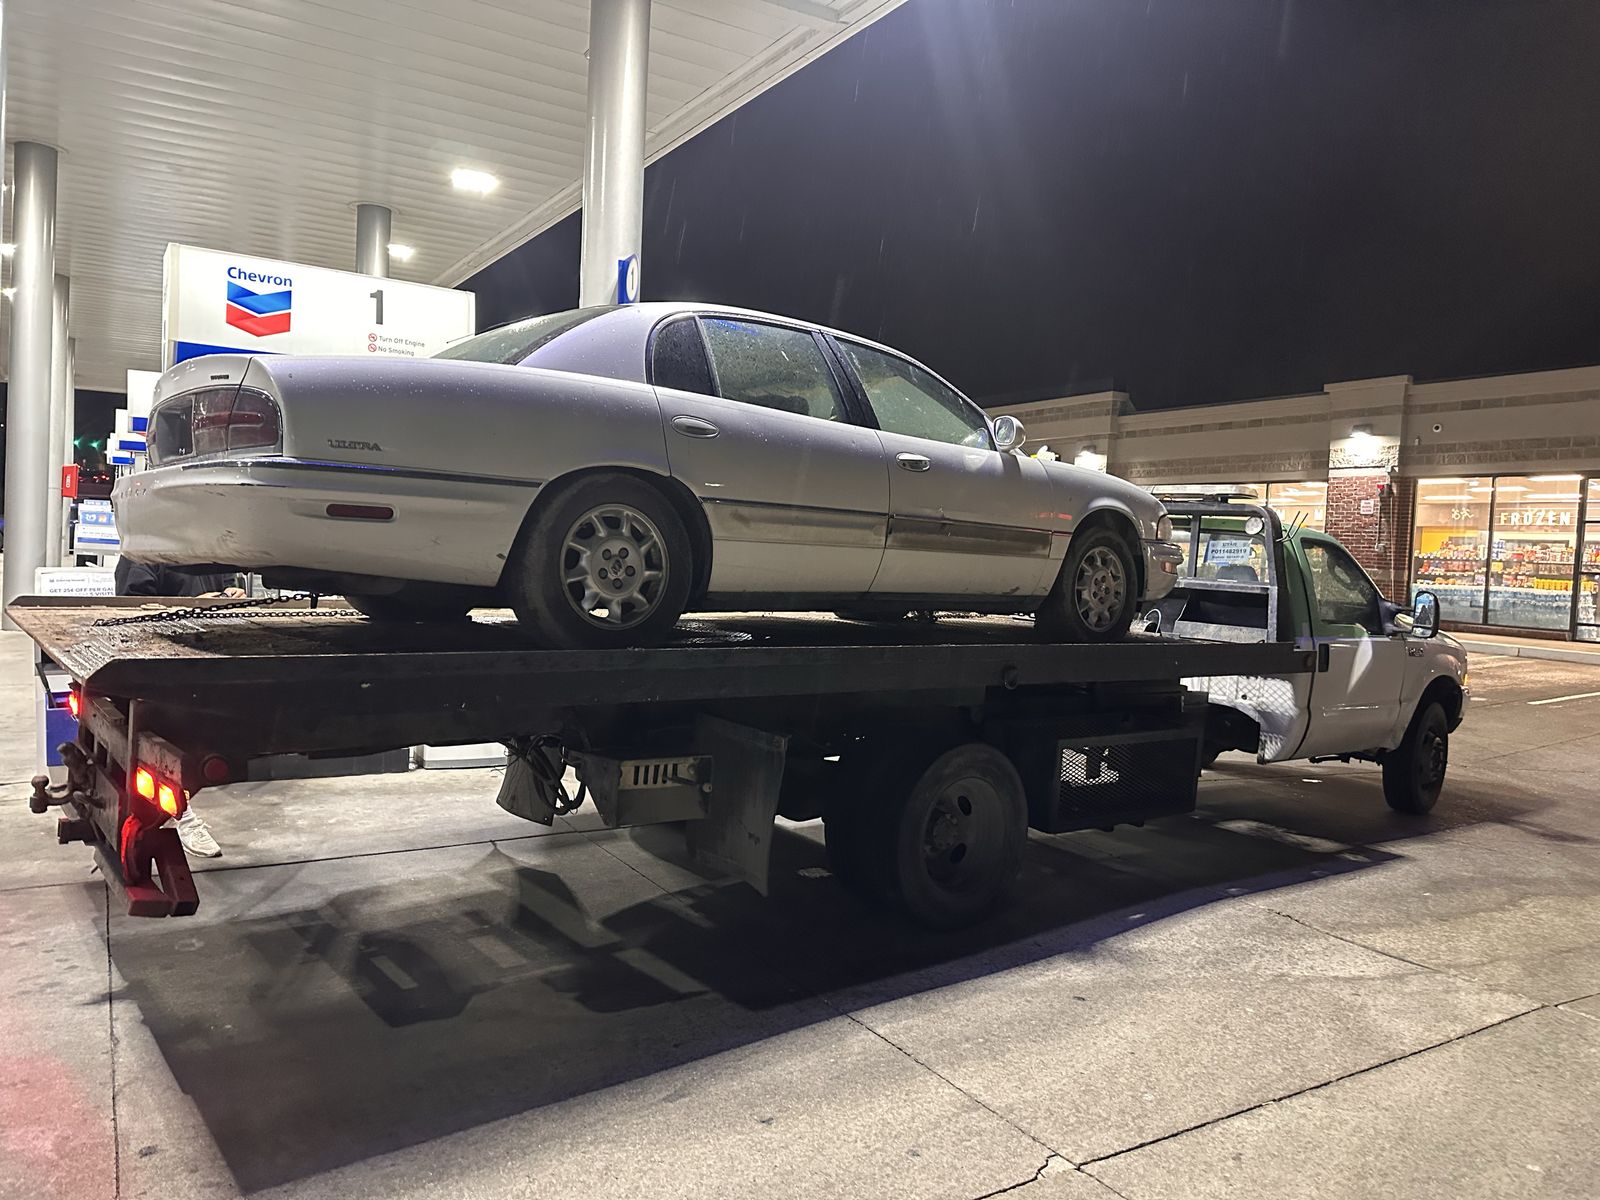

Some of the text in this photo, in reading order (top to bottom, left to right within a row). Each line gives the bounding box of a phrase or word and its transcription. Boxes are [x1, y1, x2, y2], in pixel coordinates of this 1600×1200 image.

[227, 266, 293, 288] Chevron
[370, 289, 383, 325] 1
[379, 335, 393, 343] Turn
[404, 339, 426, 348] Engine
[388, 347, 415, 357] Smoking
[1500, 511, 1571, 526] FROZEN
